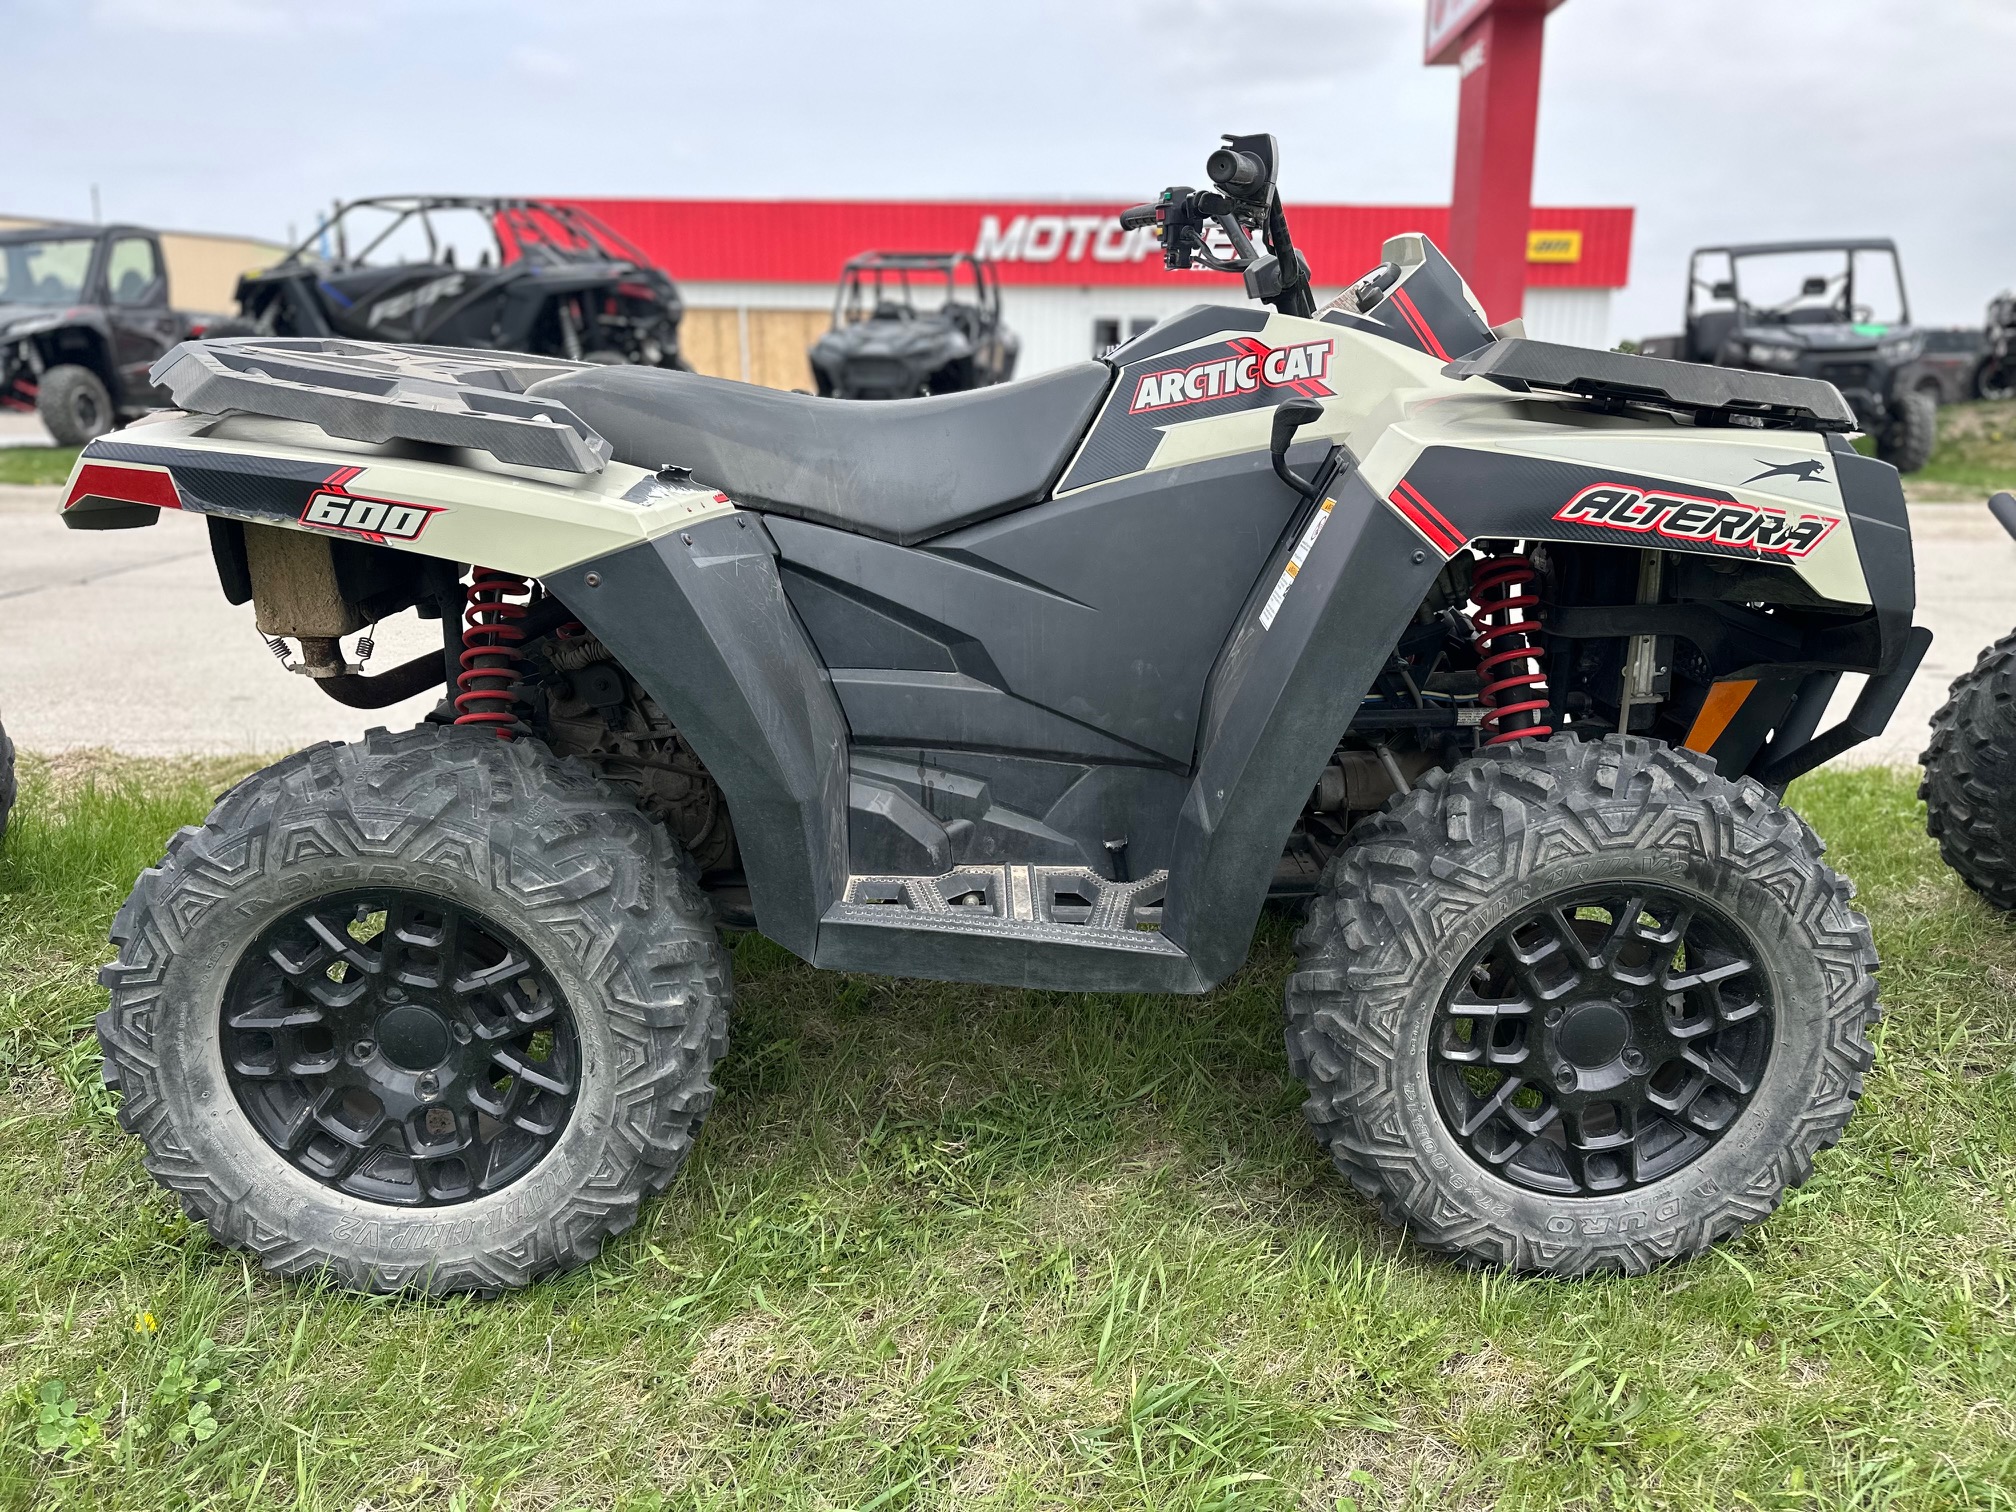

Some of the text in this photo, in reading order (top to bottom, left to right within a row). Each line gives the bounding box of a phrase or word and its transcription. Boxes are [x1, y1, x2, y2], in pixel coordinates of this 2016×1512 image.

[1134, 340, 1332, 411] ARCTIC CAT
[306, 493, 429, 536] 600
[1564, 489, 1826, 550] ALTERRA
[277, 862, 458, 901] DURO
[1641, 857, 1689, 880] V2
[333, 1216, 380, 1248] V2
[1547, 1198, 1682, 1236] DURO
